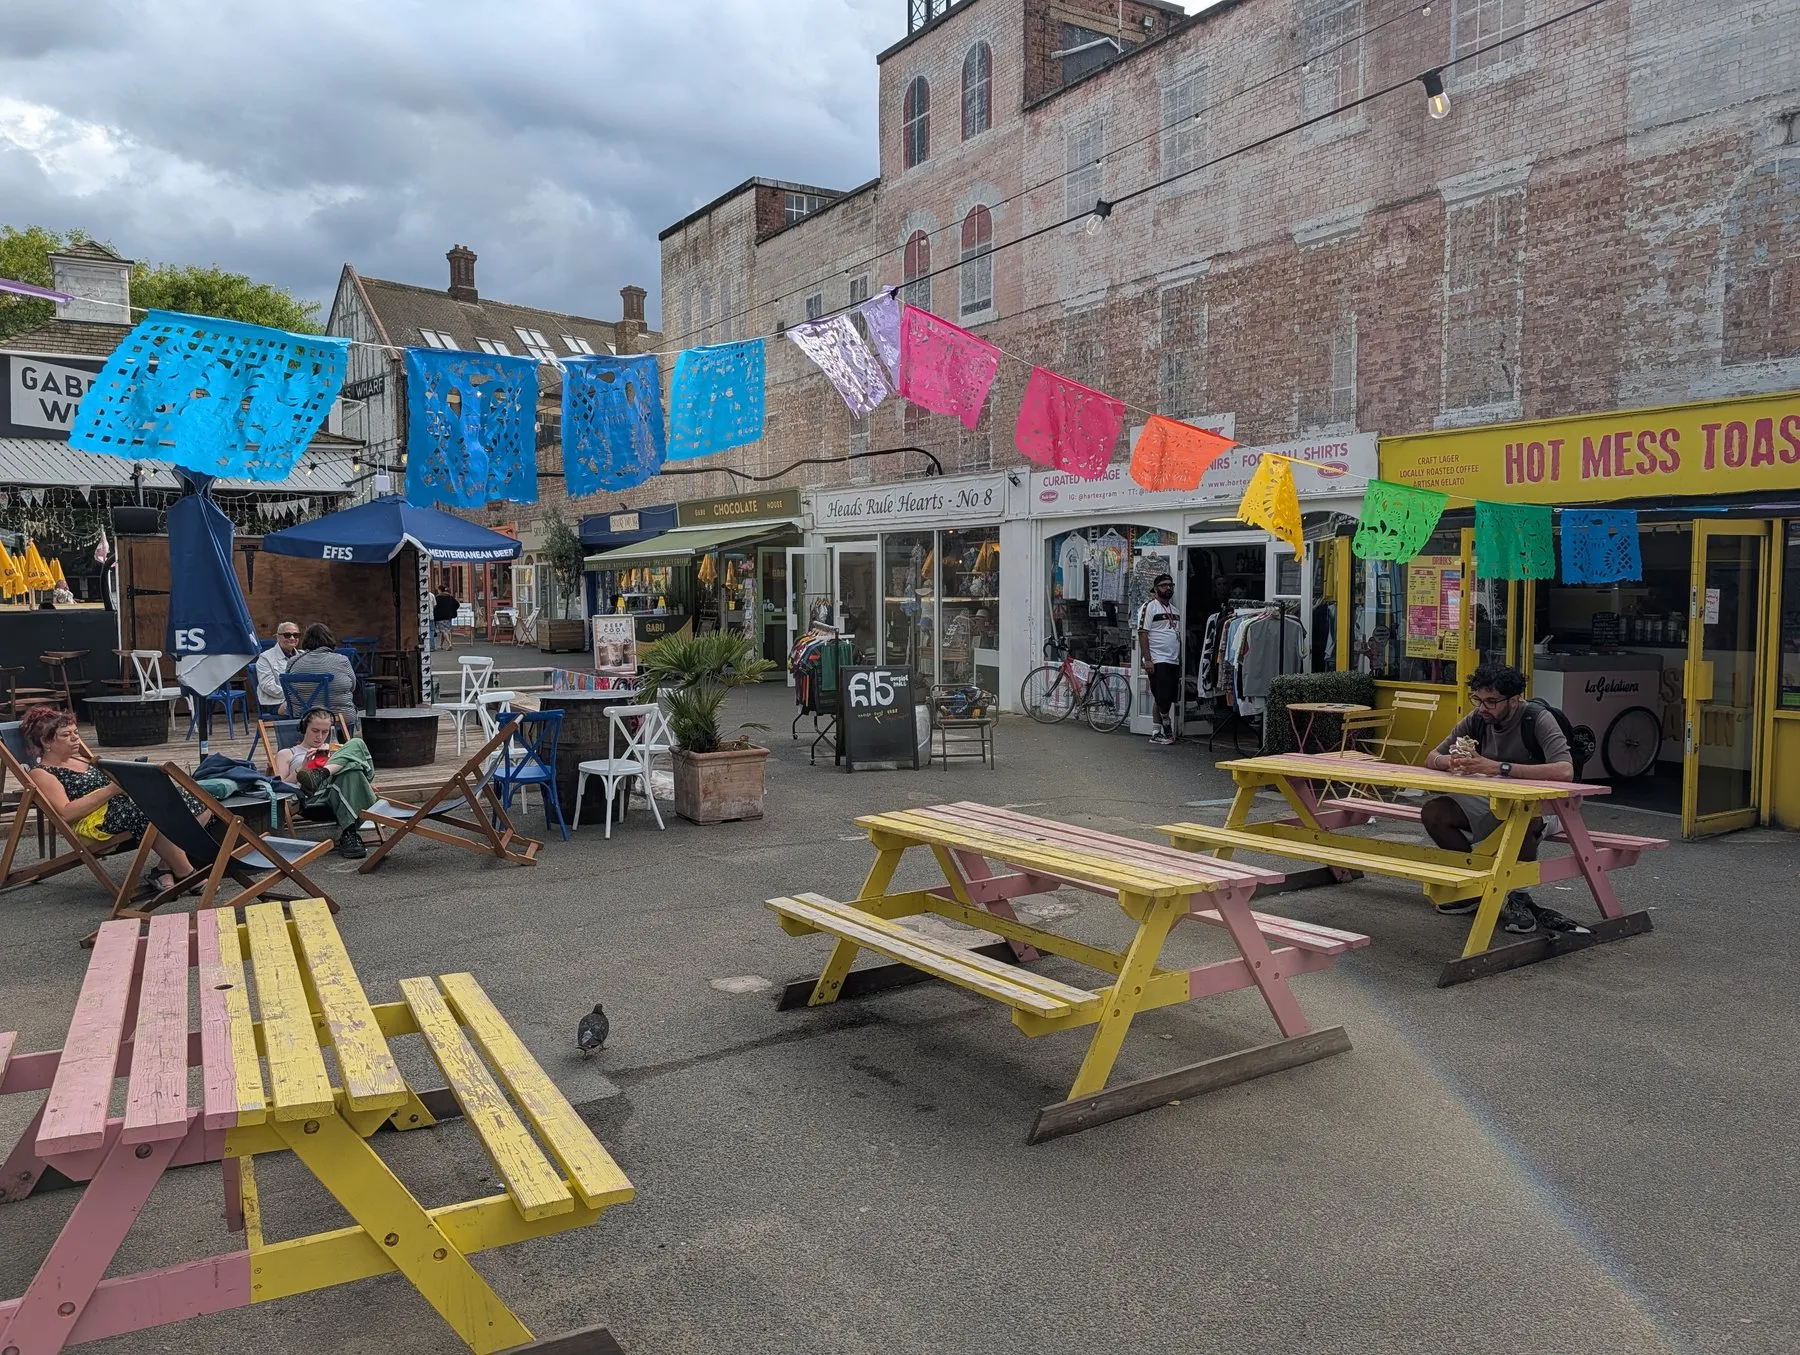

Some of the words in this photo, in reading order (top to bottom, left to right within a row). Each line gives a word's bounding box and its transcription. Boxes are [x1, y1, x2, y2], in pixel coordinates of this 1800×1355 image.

[355, 376, 384, 399] WHARF
[1303, 442, 1349, 461] SHIRTS
[1505, 438, 1565, 485] HOT
[1581, 427, 1681, 479] MESS
[1701, 414, 1800, 470] TOAS
[1417, 455, 1438, 466] CRAFT
[1439, 454, 1460, 464] LAGER
[1399, 469, 1425, 479] LOCALLY
[1426, 466, 1455, 476] ROASTED
[1455, 464, 1480, 474] COFFEE
[1042, 474, 1080, 488] CURATED
[1207, 478, 1251, 489] www.hartex
[1413, 478, 1440, 489] ARTISAN
[1441, 477, 1465, 487] GELATO
[713, 500, 758, 516] CHOCOLATE
[826, 497, 863, 518] Heads
[866, 494, 894, 515] Rule
[896, 491, 944, 513] Hearts
[955, 488, 979, 508] No
[983, 488, 993, 506] 8
[322, 545, 353, 561] EFES
[428, 547, 493, 560] MEDITERRANEAN
[494, 548, 514, 558] BEER
[645, 623, 665, 633] GABU
[848, 671, 895, 708] £15
